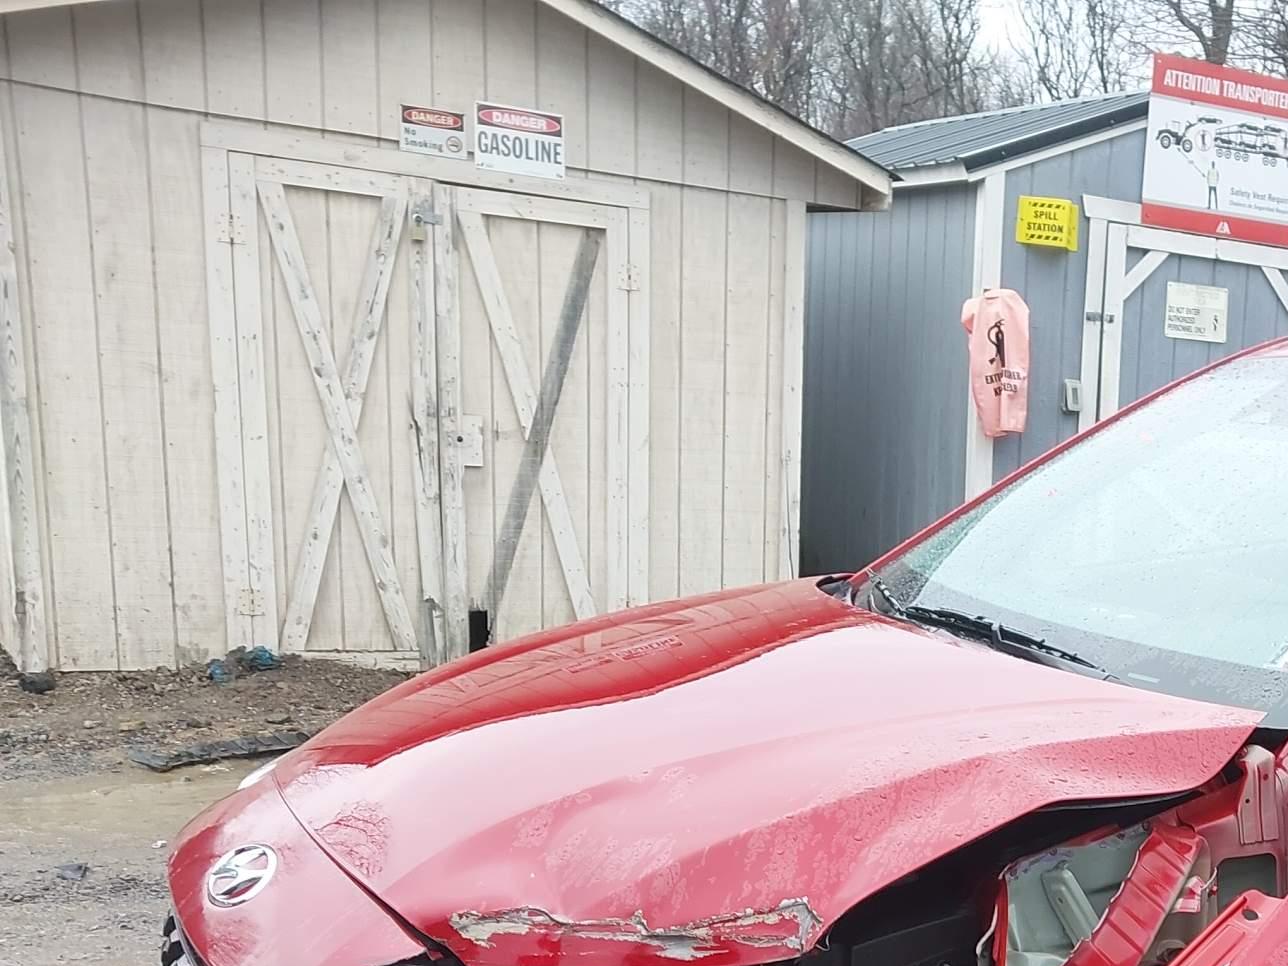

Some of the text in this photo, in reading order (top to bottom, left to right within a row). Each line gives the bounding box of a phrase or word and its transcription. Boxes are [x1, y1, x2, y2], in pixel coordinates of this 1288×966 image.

[1164, 69, 1220, 96] ATTENTION
[411, 111, 454, 125] DANGER
[492, 110, 547, 130] DANGER
[404, 127, 416, 136] No
[478, 131, 562, 165] GASOLINE
[1033, 210, 1058, 221] SPILL
[1026, 222, 1064, 234] STATION
